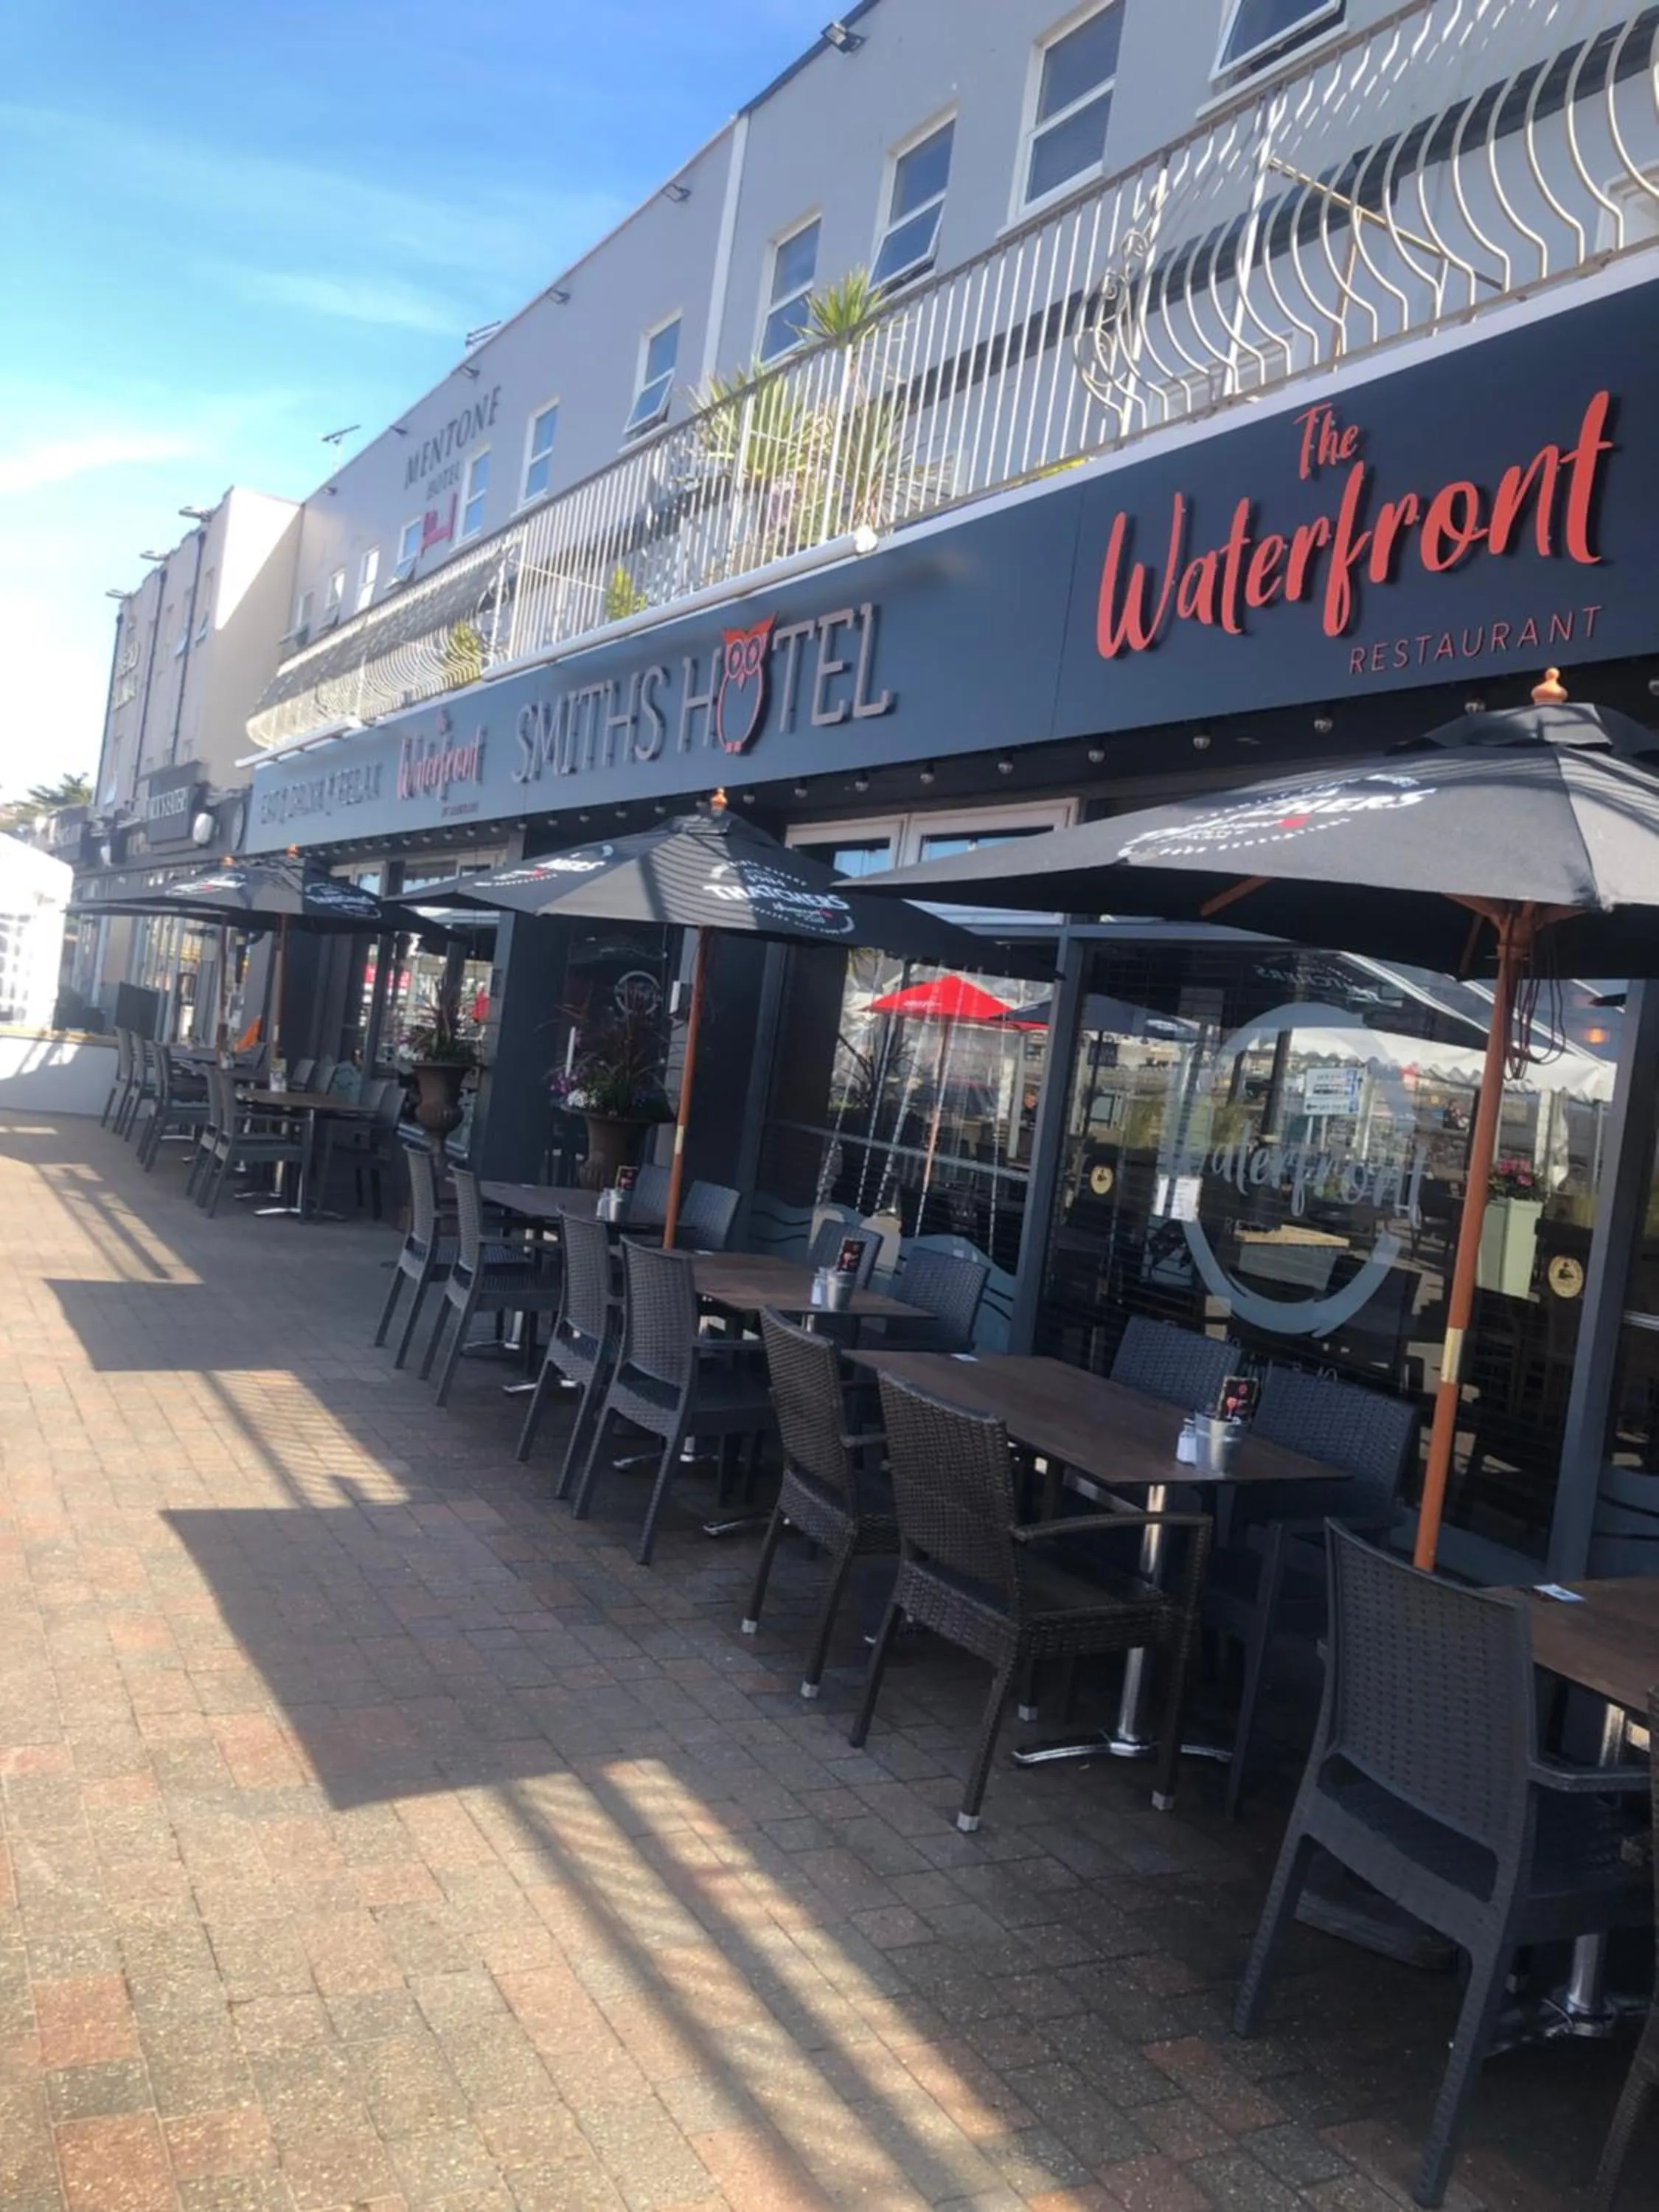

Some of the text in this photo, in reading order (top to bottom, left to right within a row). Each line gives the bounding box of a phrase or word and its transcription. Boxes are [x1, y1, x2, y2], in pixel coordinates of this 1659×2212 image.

[404, 385, 502, 490] MENTONE
[1293, 403, 1359, 480] The
[425, 461, 462, 500] HOTEL
[1096, 390, 1614, 660] Waterfront
[1350, 605, 1602, 674] RESTAURANT
[512, 666, 669, 783] SMITHS
[703, 884, 850, 910] THATCHERS
